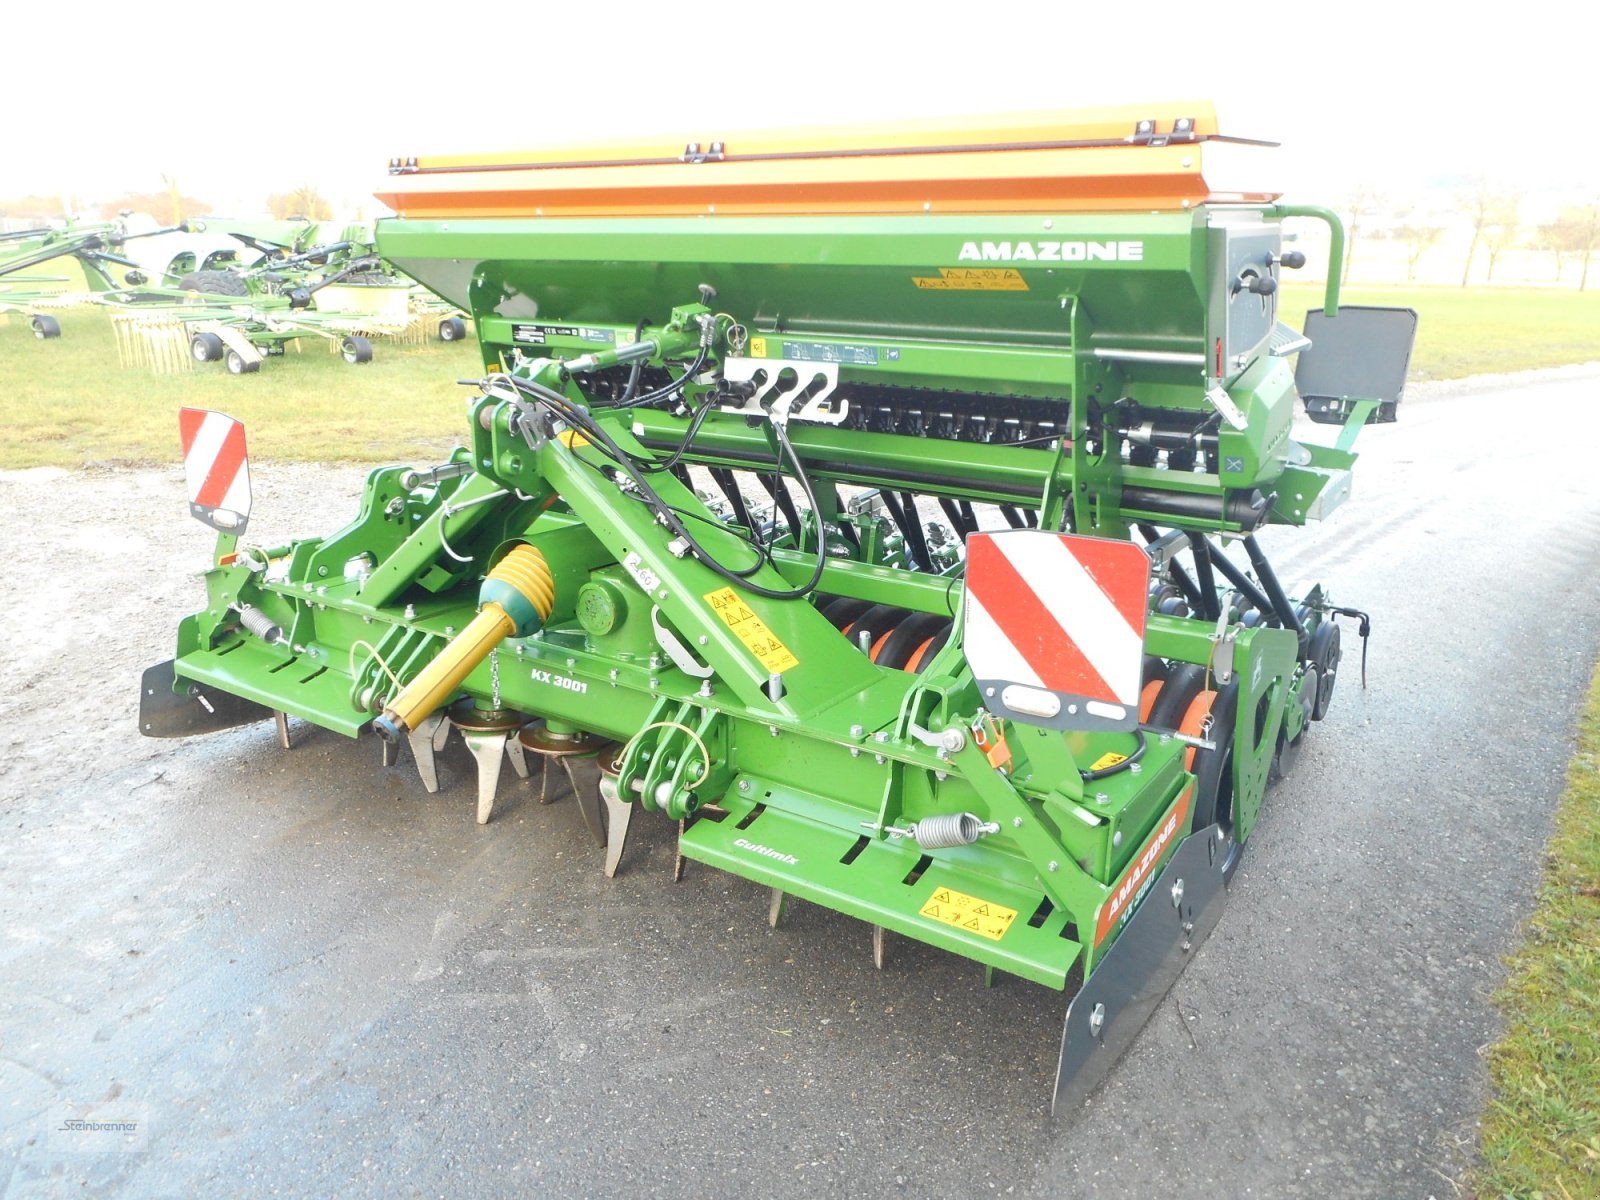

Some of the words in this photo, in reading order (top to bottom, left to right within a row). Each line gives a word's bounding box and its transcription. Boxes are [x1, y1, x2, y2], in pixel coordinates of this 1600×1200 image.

[958, 241, 1143, 262] AMAZONE
[531, 668, 552, 684] KX
[553, 675, 588, 694] 3001
[733, 838, 800, 865] Cultimix
[1108, 812, 1177, 921] AMAZONE
